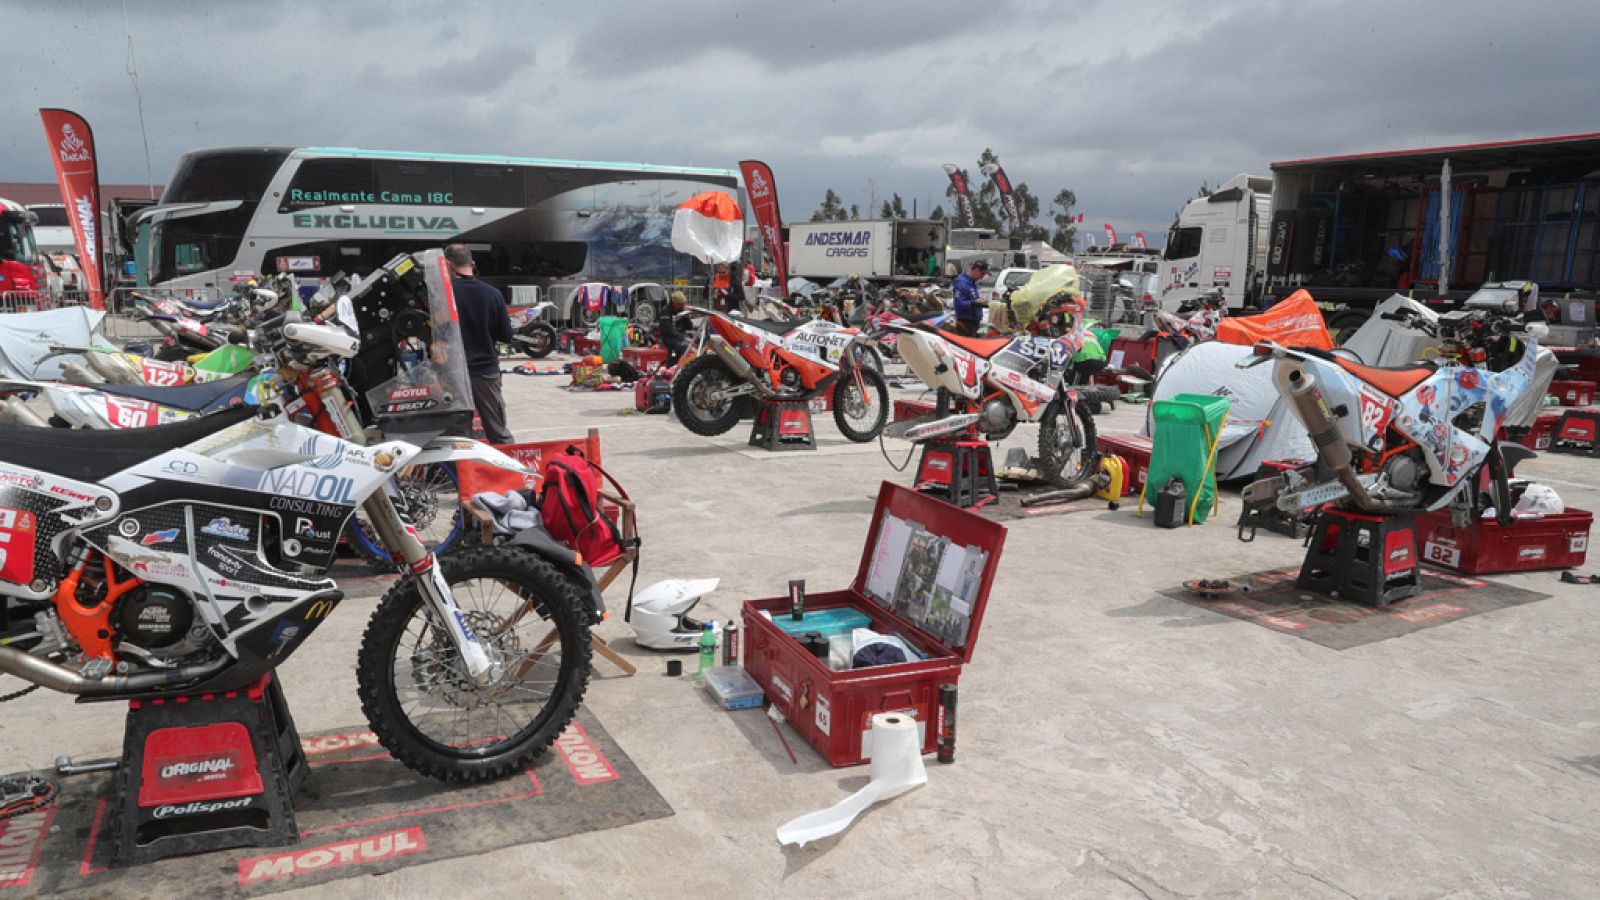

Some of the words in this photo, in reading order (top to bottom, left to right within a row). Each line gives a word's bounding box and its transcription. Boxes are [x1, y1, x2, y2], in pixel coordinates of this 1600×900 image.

[291, 188, 376, 203] Realmente
[380, 190, 422, 204] Cama
[293, 214, 459, 231] EXCLUCIVA
[804, 231, 872, 247] ANDESMAR
[826, 247, 869, 258] CARGAS
[148, 368, 178, 386] 122
[392, 388, 428, 399] MOTUL
[118, 407, 148, 428] 60
[1363, 401, 1384, 432] 82
[258, 469, 357, 504] NADOIL
[270, 496, 343, 518] CONSULTING
[1431, 545, 1453, 563] 82
[161, 757, 235, 779] ORIGINAL
[153, 796, 252, 819] Polisport
[248, 831, 419, 880] MOTUL
